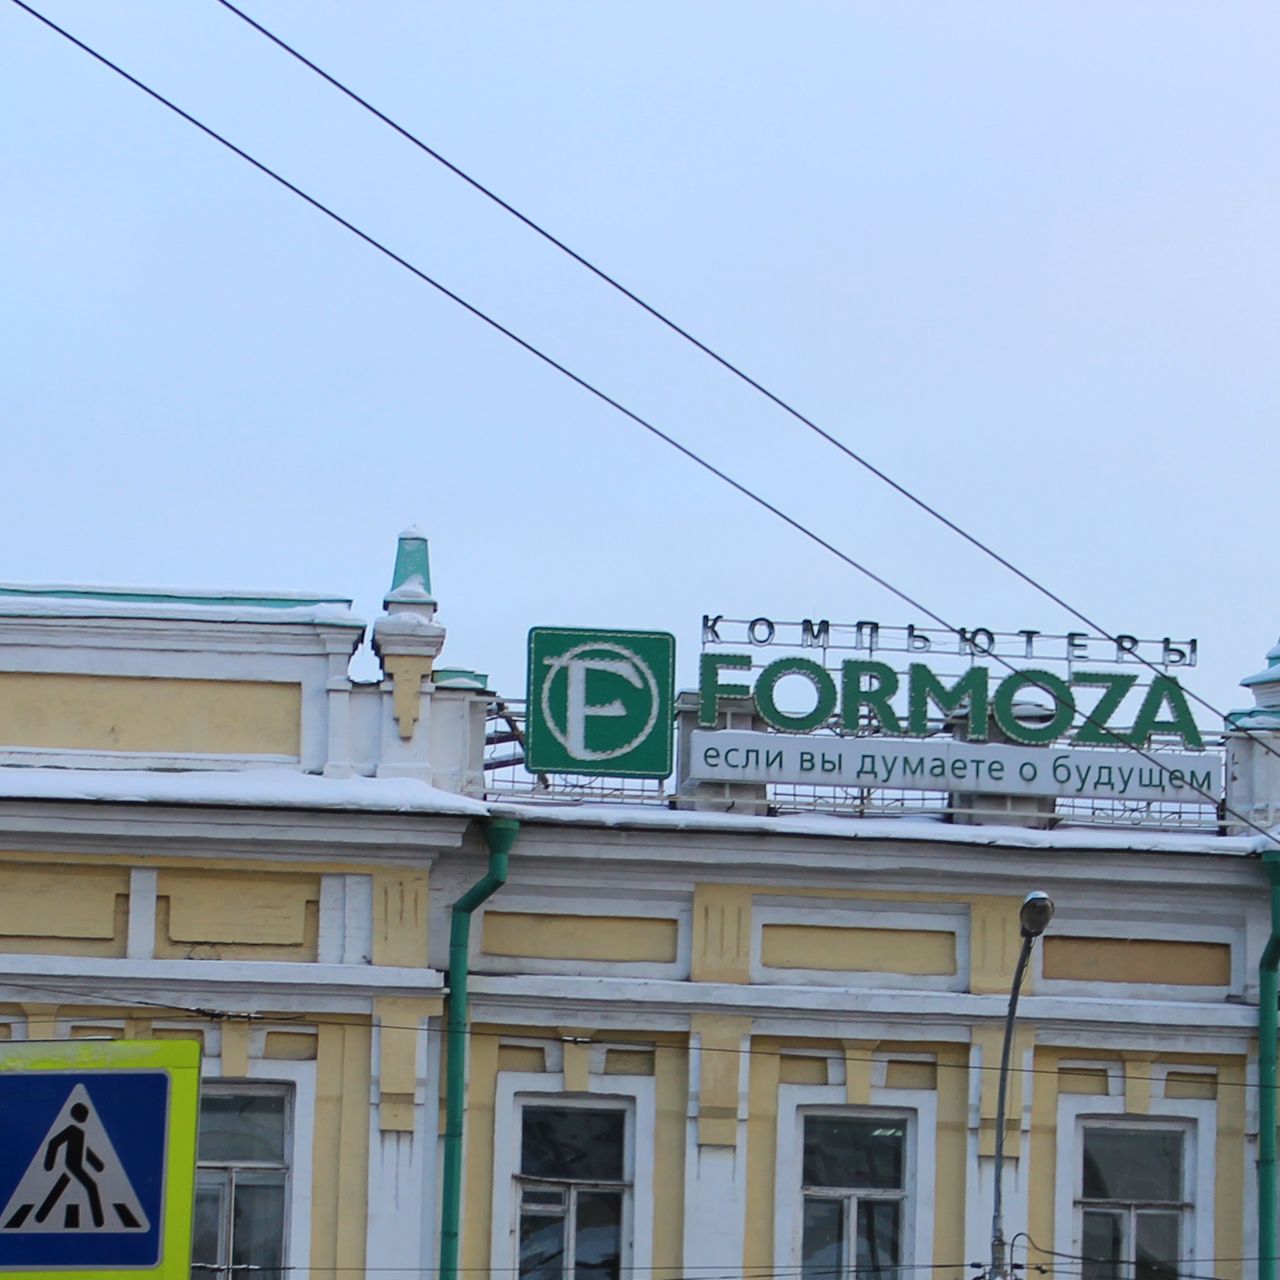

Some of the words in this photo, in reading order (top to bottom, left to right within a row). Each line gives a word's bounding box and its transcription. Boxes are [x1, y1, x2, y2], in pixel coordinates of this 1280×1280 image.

[701, 615, 1199, 667] КОМПЬЮТЕРЫ
[698, 652, 1204, 750] FORMOZA
[703, 743, 786, 769] если
[799, 753, 843, 773] вы
[857, 753, 1006, 783] думаете
[1019, 763, 1038, 782] о
[1052, 755, 1214, 794] будущем
